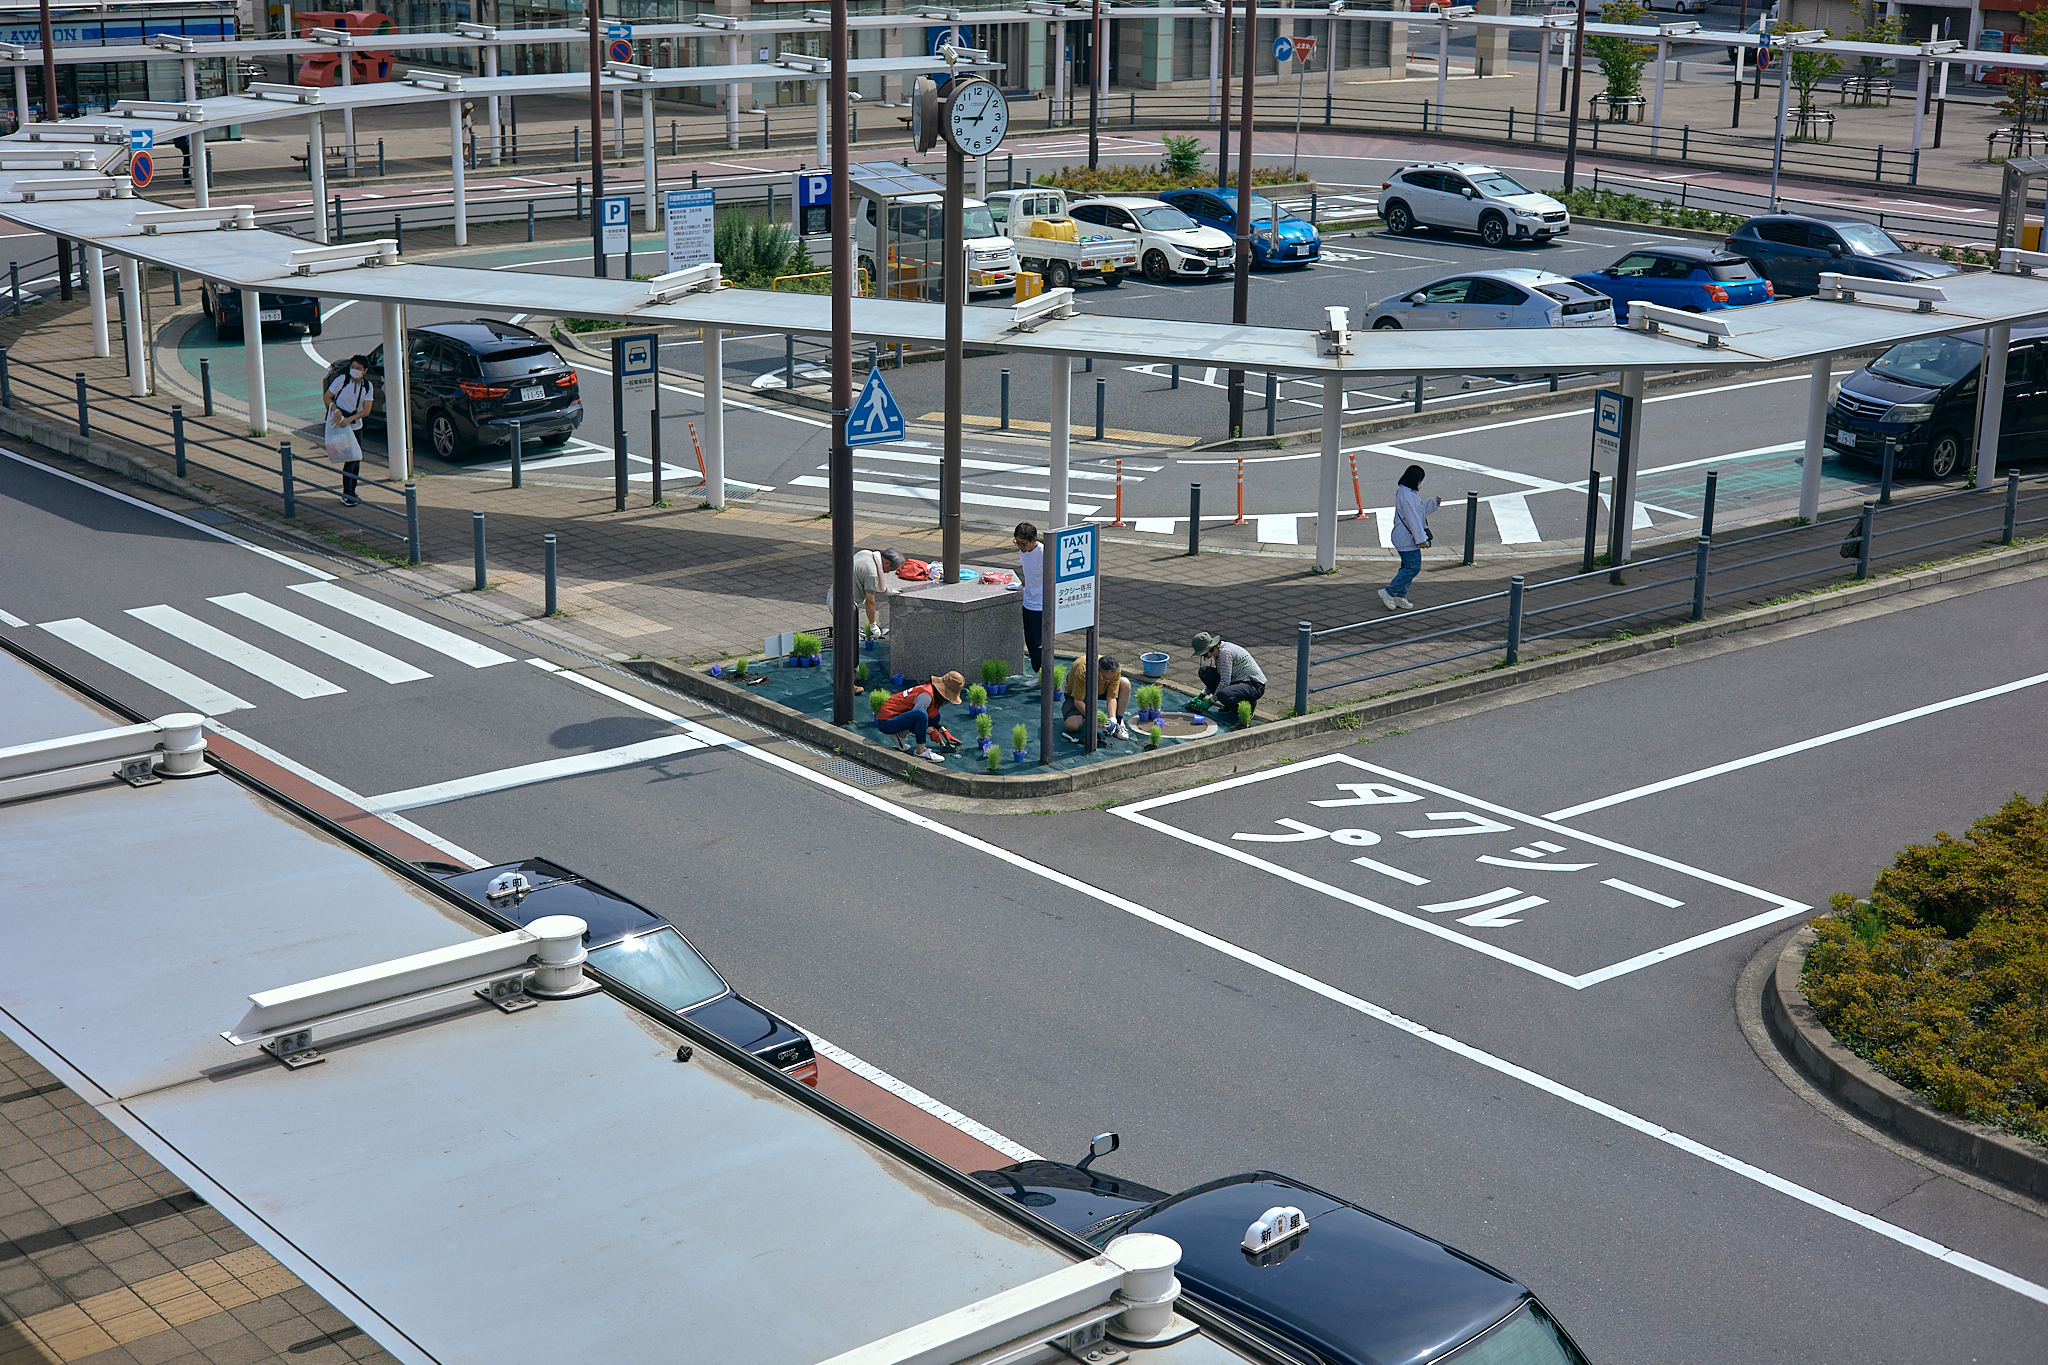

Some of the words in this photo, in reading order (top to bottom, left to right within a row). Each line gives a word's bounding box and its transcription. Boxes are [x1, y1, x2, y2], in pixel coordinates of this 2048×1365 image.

[0, 28, 77, 42] AWON
[809, 176, 827, 204] P
[610, 204, 621, 220] P
[1063, 534, 1088, 548] TAXI
[1059, 583, 1092, 596] タクシー専用
[1308, 783, 1685, 908] タクシー
[1231, 817, 1550, 927] プール
[498, 878, 522, 891] 本町
[1261, 1213, 1300, 1244] 新星
